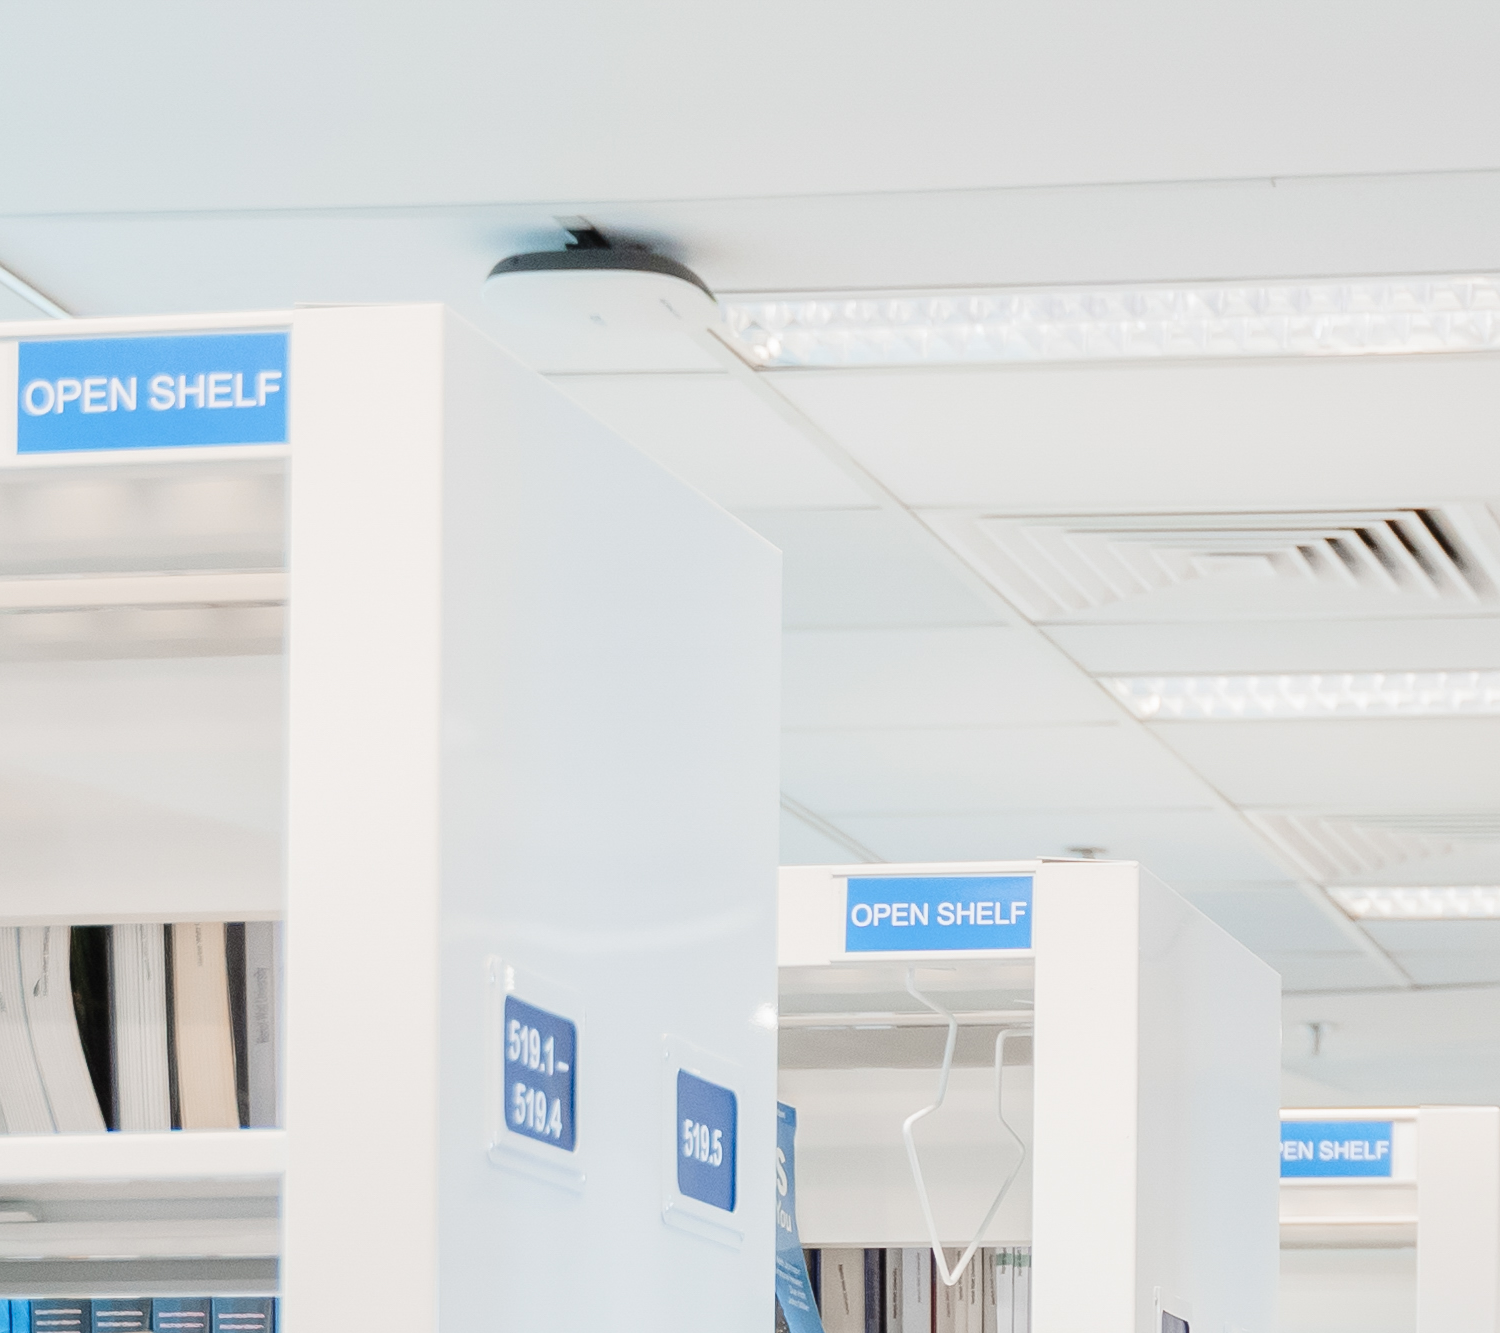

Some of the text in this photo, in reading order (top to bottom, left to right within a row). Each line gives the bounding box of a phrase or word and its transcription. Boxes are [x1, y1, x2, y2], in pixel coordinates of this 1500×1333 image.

[24, 370, 283, 416] OPEN SHELF
[851, 901, 1028, 927] OPEN SHELF
[513, 1082, 563, 1139] 519.4
[683, 1118, 724, 1168] 519.5
[1279, 1140, 1390, 1161] EN SHELF
